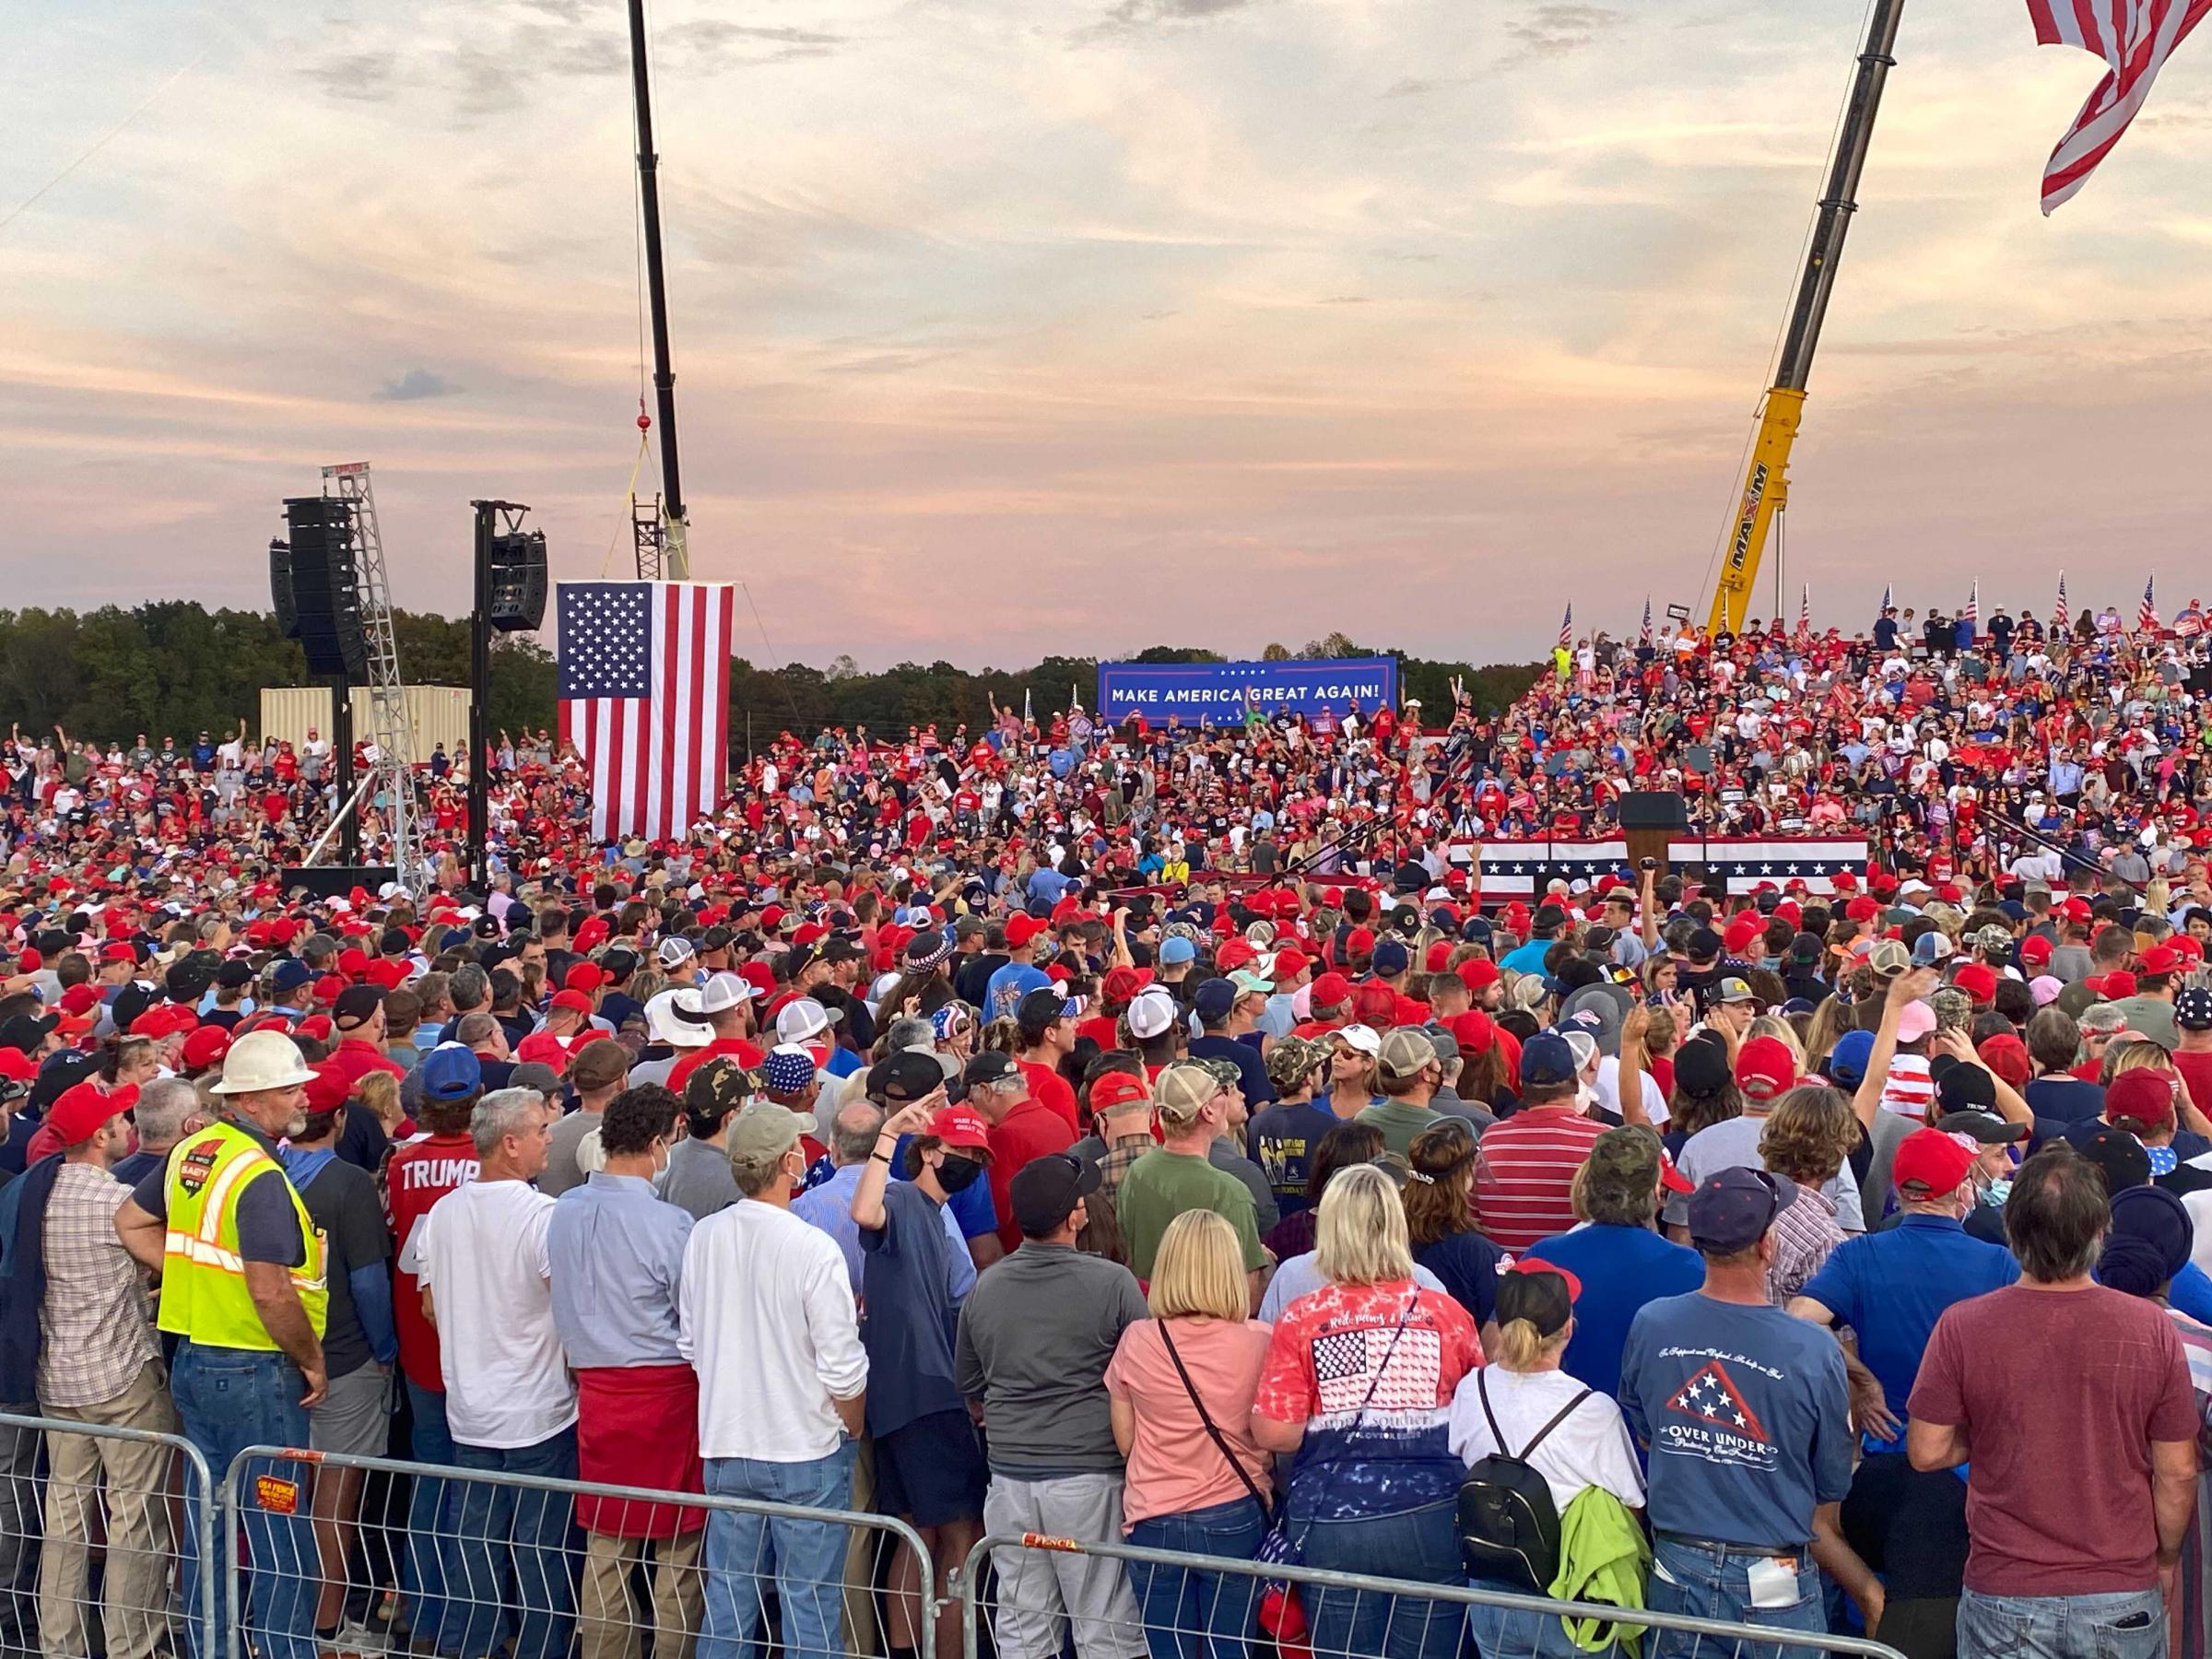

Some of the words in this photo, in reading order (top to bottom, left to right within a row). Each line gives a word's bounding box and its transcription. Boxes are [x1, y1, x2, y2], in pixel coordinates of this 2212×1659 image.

[1731, 462, 1769, 570] MAXIM
[1112, 688, 1158, 702] MAKE
[1164, 688, 1242, 702] AMERICA
[1250, 687, 1308, 701] GREAT
[1315, 685, 1380, 700] AGAIN!
[402, 1159, 480, 1190] TRUMP
[1668, 1425, 1711, 1442] OVER
[1715, 1432, 1766, 1455] UNDER
